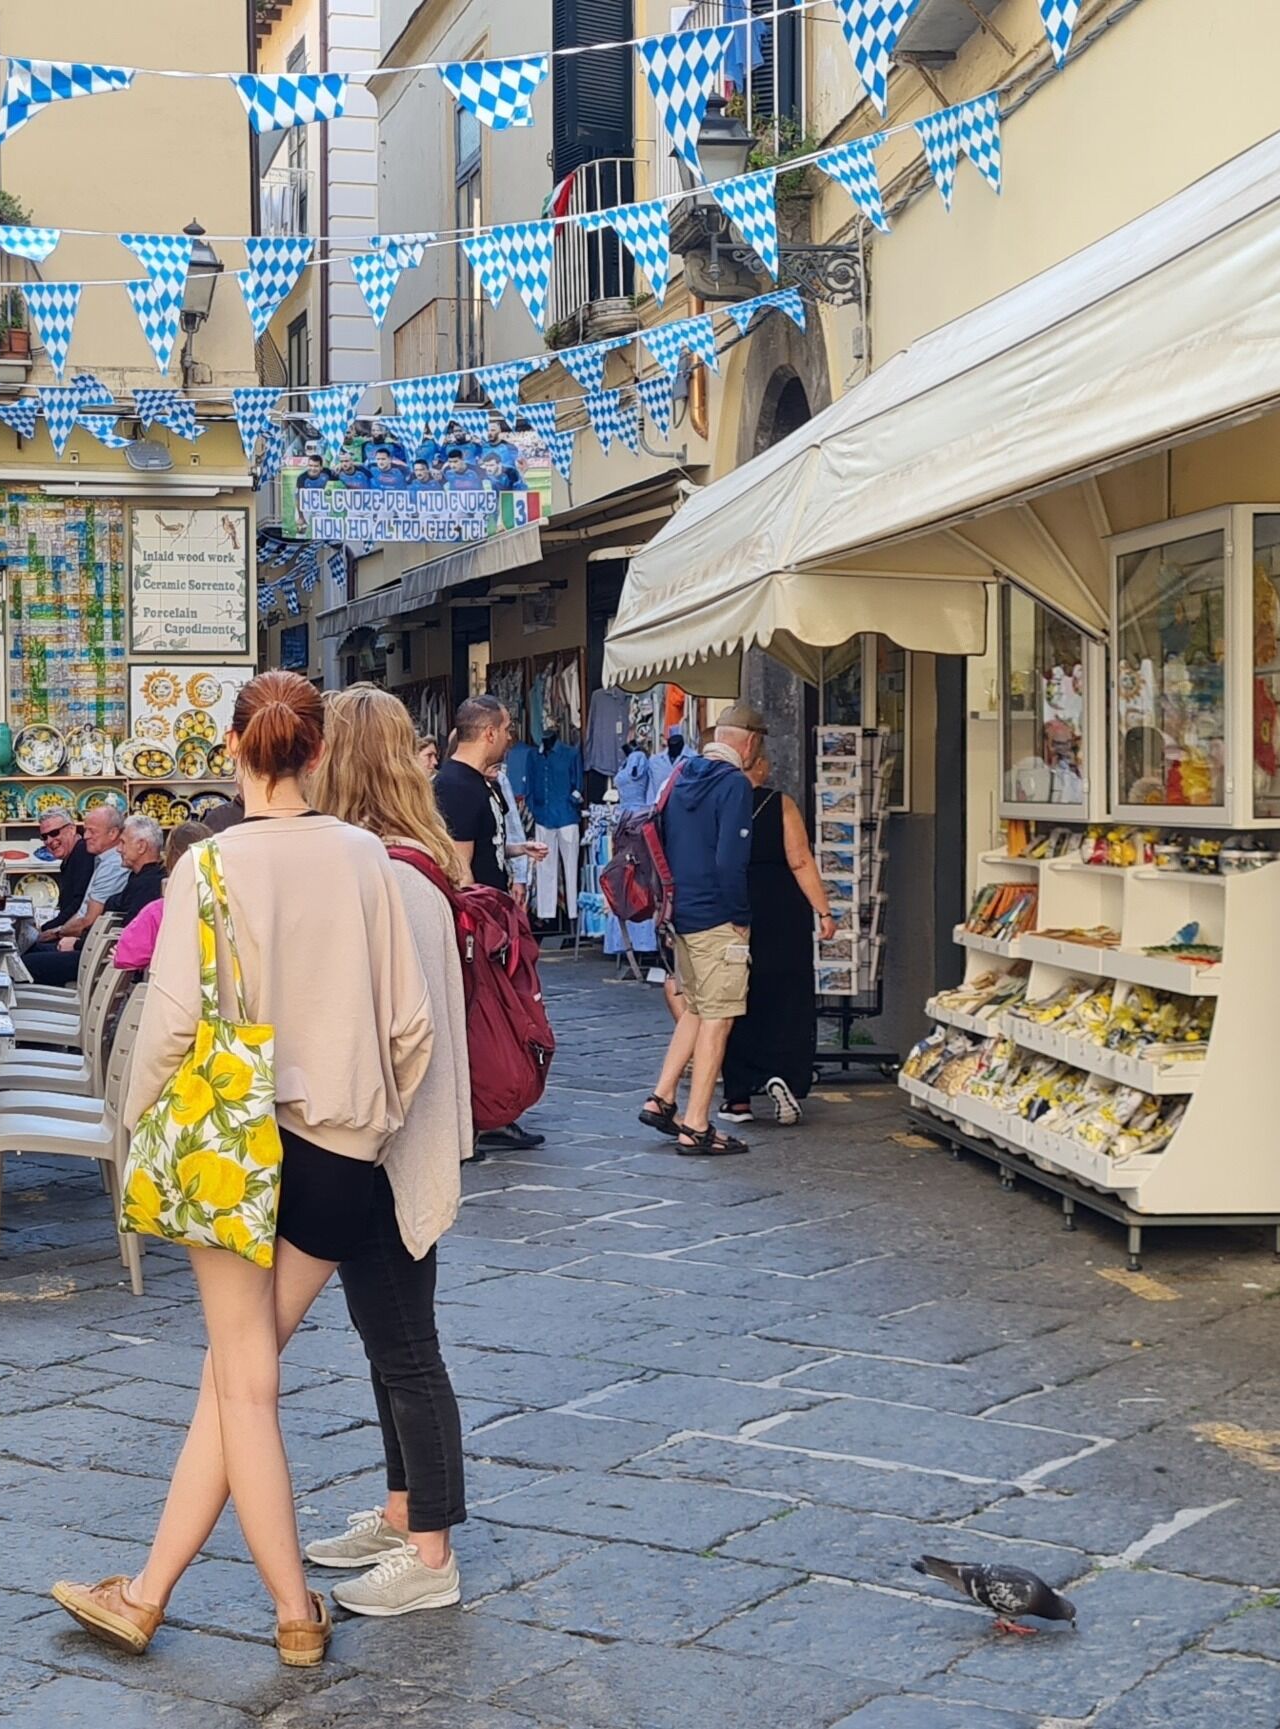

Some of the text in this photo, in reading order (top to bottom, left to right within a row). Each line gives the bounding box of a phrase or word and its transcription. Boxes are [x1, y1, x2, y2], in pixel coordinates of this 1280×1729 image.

[301, 490, 329, 511] NEL
[387, 492, 415, 512] DEL
[419, 492, 445, 513] MIO
[515, 499, 527, 526] 3
[314, 519, 342, 538] NON
[347, 519, 369, 539] HO
[375, 520, 421, 539] ALTRO
[426, 520, 457, 540] CHE
[143, 550, 236, 563] Inlaid wood work
[143, 578, 236, 592] Ceramic Sorrento
[143, 606, 198, 619] Porcelain
[164, 623, 236, 637] Capodimonte
